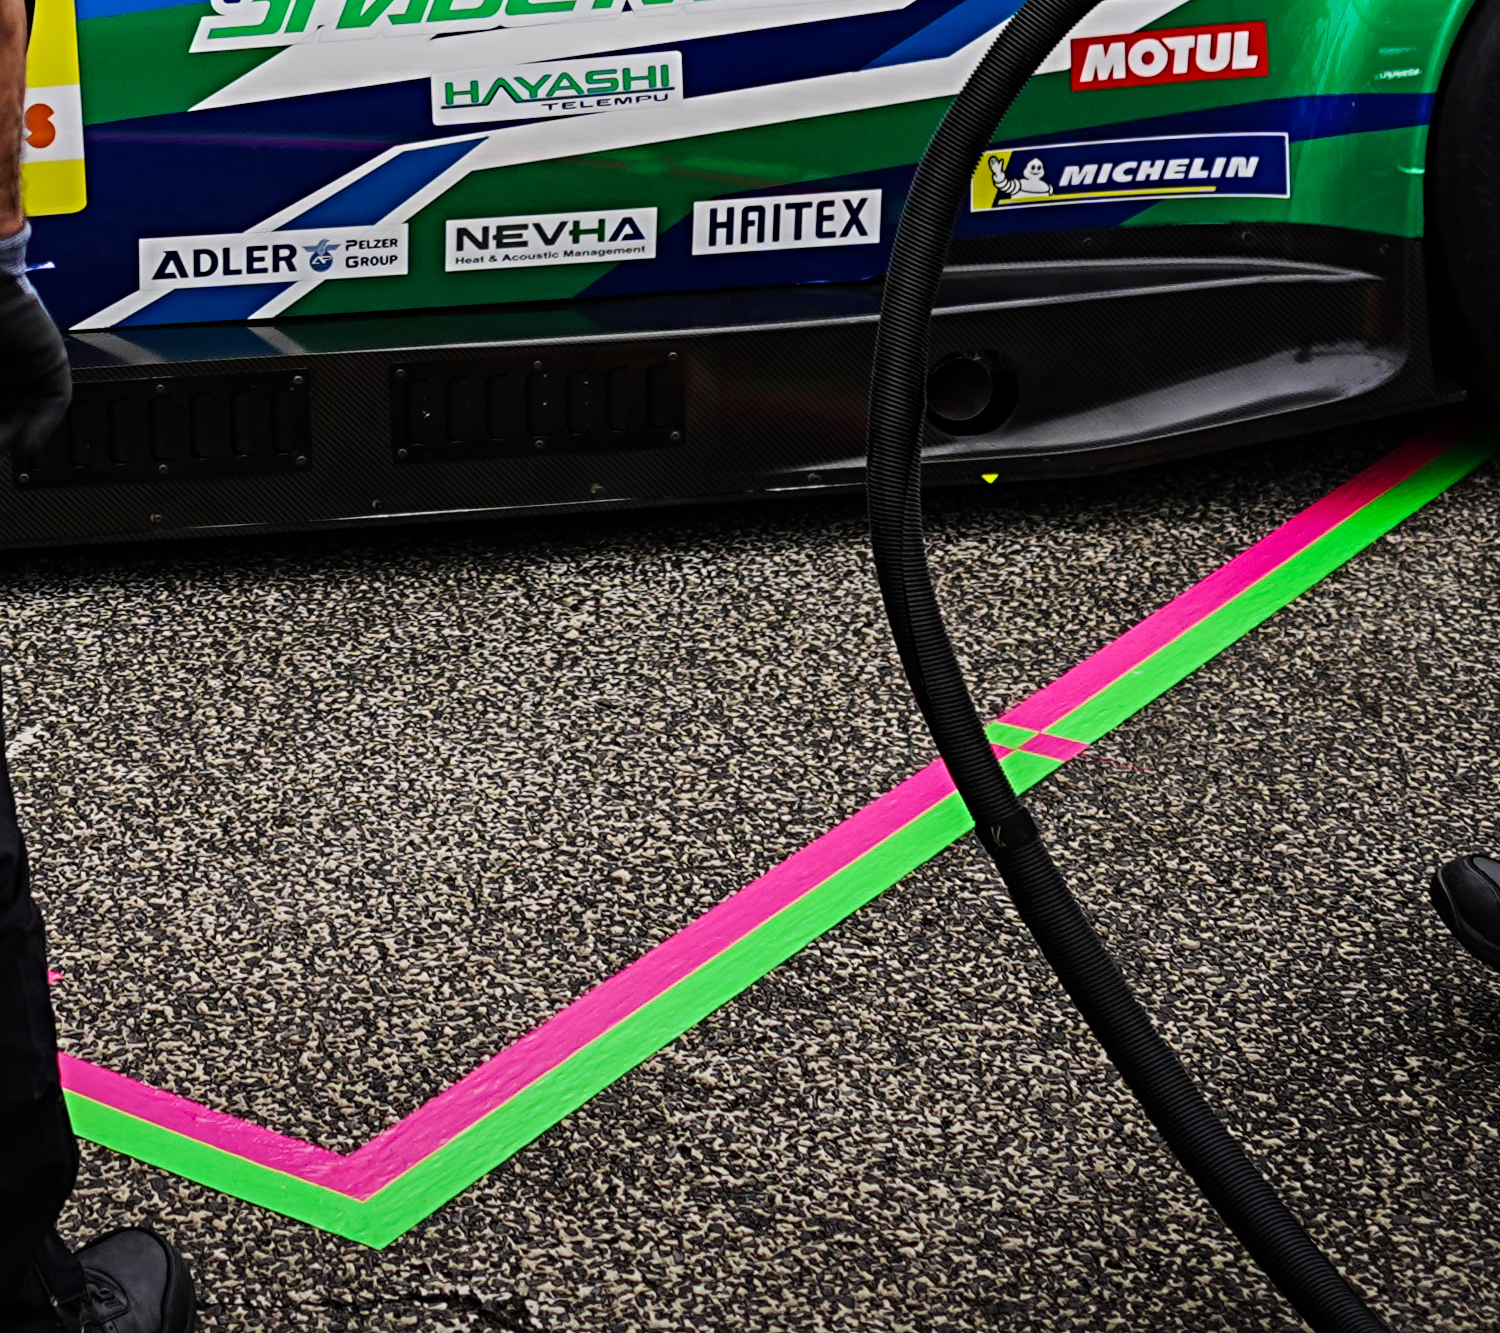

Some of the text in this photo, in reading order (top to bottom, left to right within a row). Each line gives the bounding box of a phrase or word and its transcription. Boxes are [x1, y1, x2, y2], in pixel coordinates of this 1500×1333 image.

[1079, 31, 1259, 83] MOTUL
[442, 64, 670, 105] HAYASHI
[542, 92, 669, 112] TELEMPU
[1059, 155, 1259, 187] MICHELIN
[457, 217, 645, 252] NEVHA
[709, 195, 864, 247] HAITEX
[345, 238, 399, 252] PELZER
[345, 254, 399, 269] GROUP
[456, 245, 646, 264] Heat & Acoustic Management
[151, 244, 298, 280] ADLER
